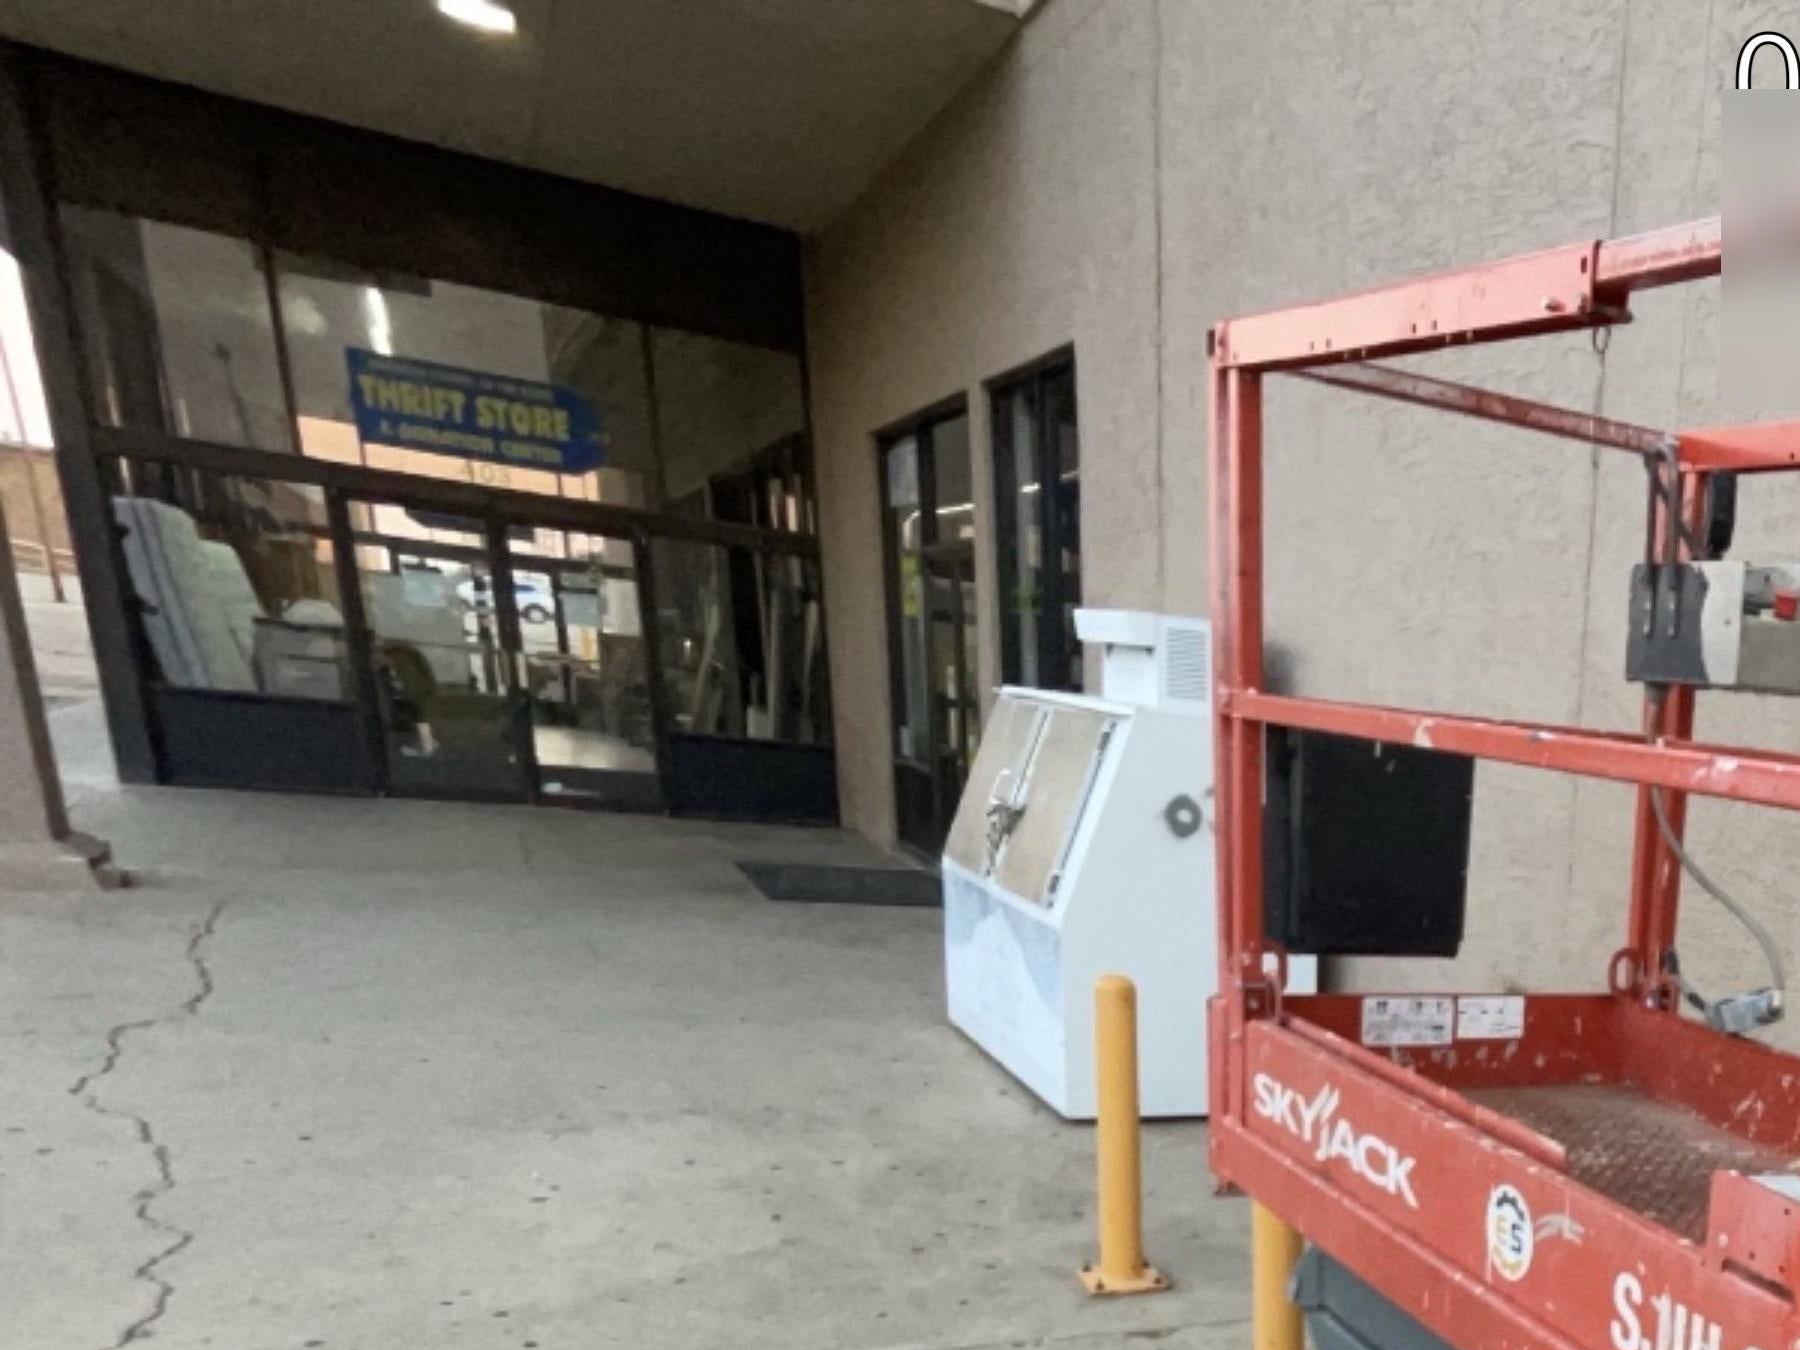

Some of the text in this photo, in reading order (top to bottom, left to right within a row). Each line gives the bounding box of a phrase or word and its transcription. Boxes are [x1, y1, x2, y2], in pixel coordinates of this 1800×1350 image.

[357, 374, 466, 425] THRIFT
[473, 394, 572, 442] STORE
[1253, 1073, 1419, 1210] SKYJACK
